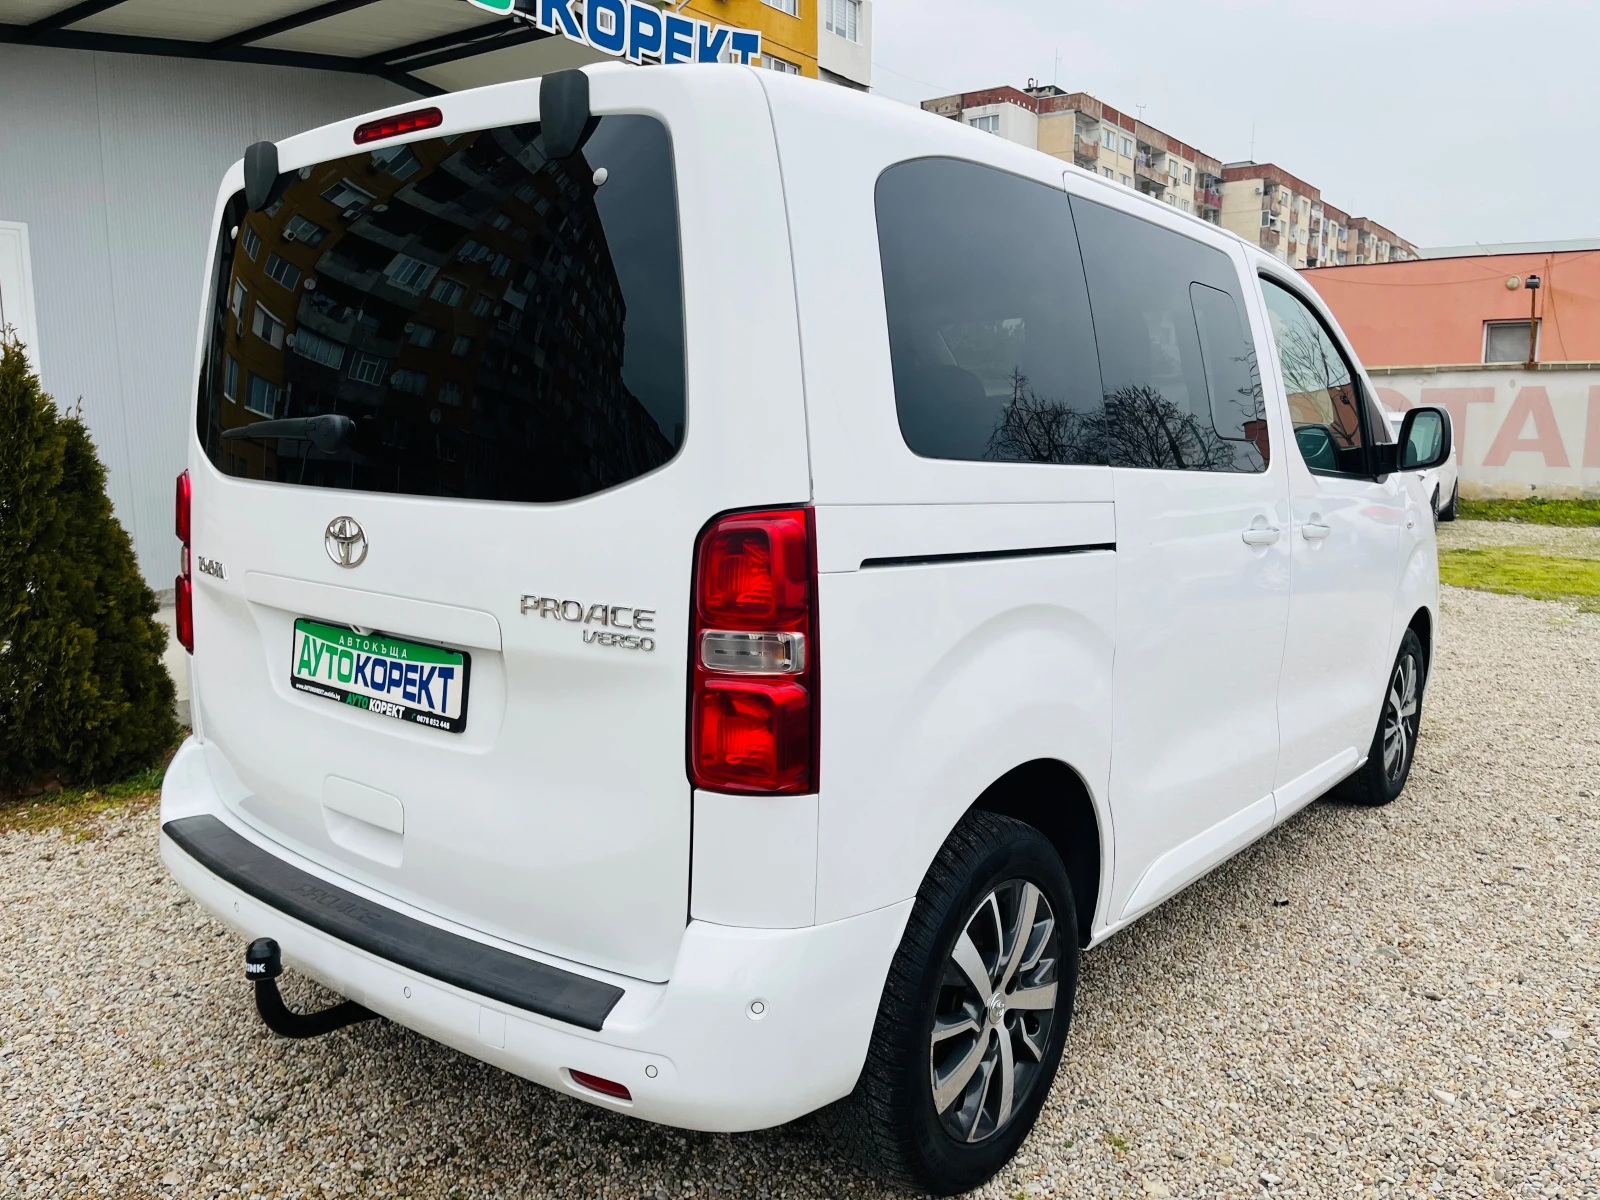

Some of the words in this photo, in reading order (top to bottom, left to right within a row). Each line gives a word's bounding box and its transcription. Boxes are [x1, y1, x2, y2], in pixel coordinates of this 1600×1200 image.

[520, 593, 656, 632] PROACE
[338, 635, 408, 659] АВТОКЪЩА
[583, 629, 656, 652] VERSO
